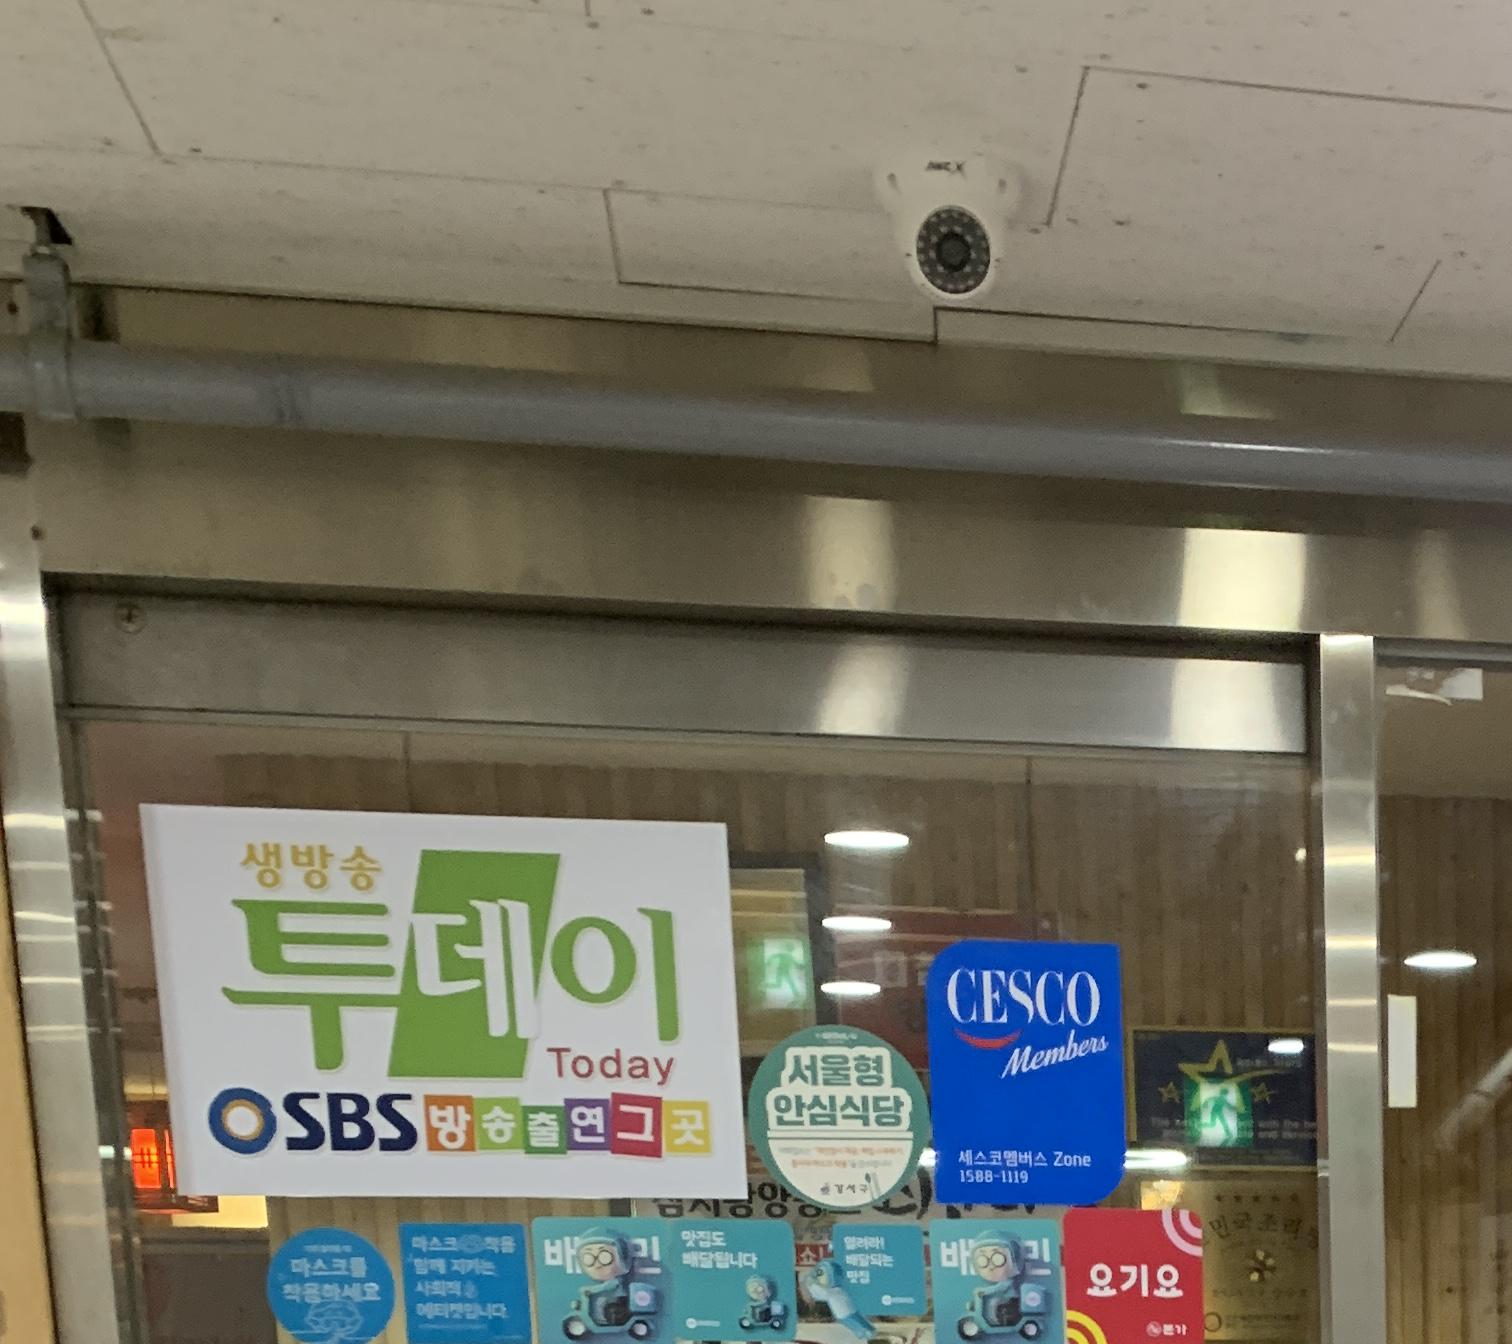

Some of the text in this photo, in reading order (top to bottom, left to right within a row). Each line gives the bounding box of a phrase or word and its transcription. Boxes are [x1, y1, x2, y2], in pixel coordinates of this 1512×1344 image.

[241, 841, 383, 892] 생방송
[220, 896, 680, 1073] 투데이
[947, 968, 1101, 1026] CESCO
[546, 1047, 676, 1086] Today
[789, 1053, 885, 1087] 서울형
[1001, 1029, 1109, 1079] Members
[283, 1091, 418, 1152] SBS
[774, 1094, 904, 1127] 안심식당
[958, 1149, 1092, 1167] 세스코멤버스 Zone
[959, 1170, 1029, 1184] 1588-1119
[1087, 1263, 1183, 1298] 요기요
